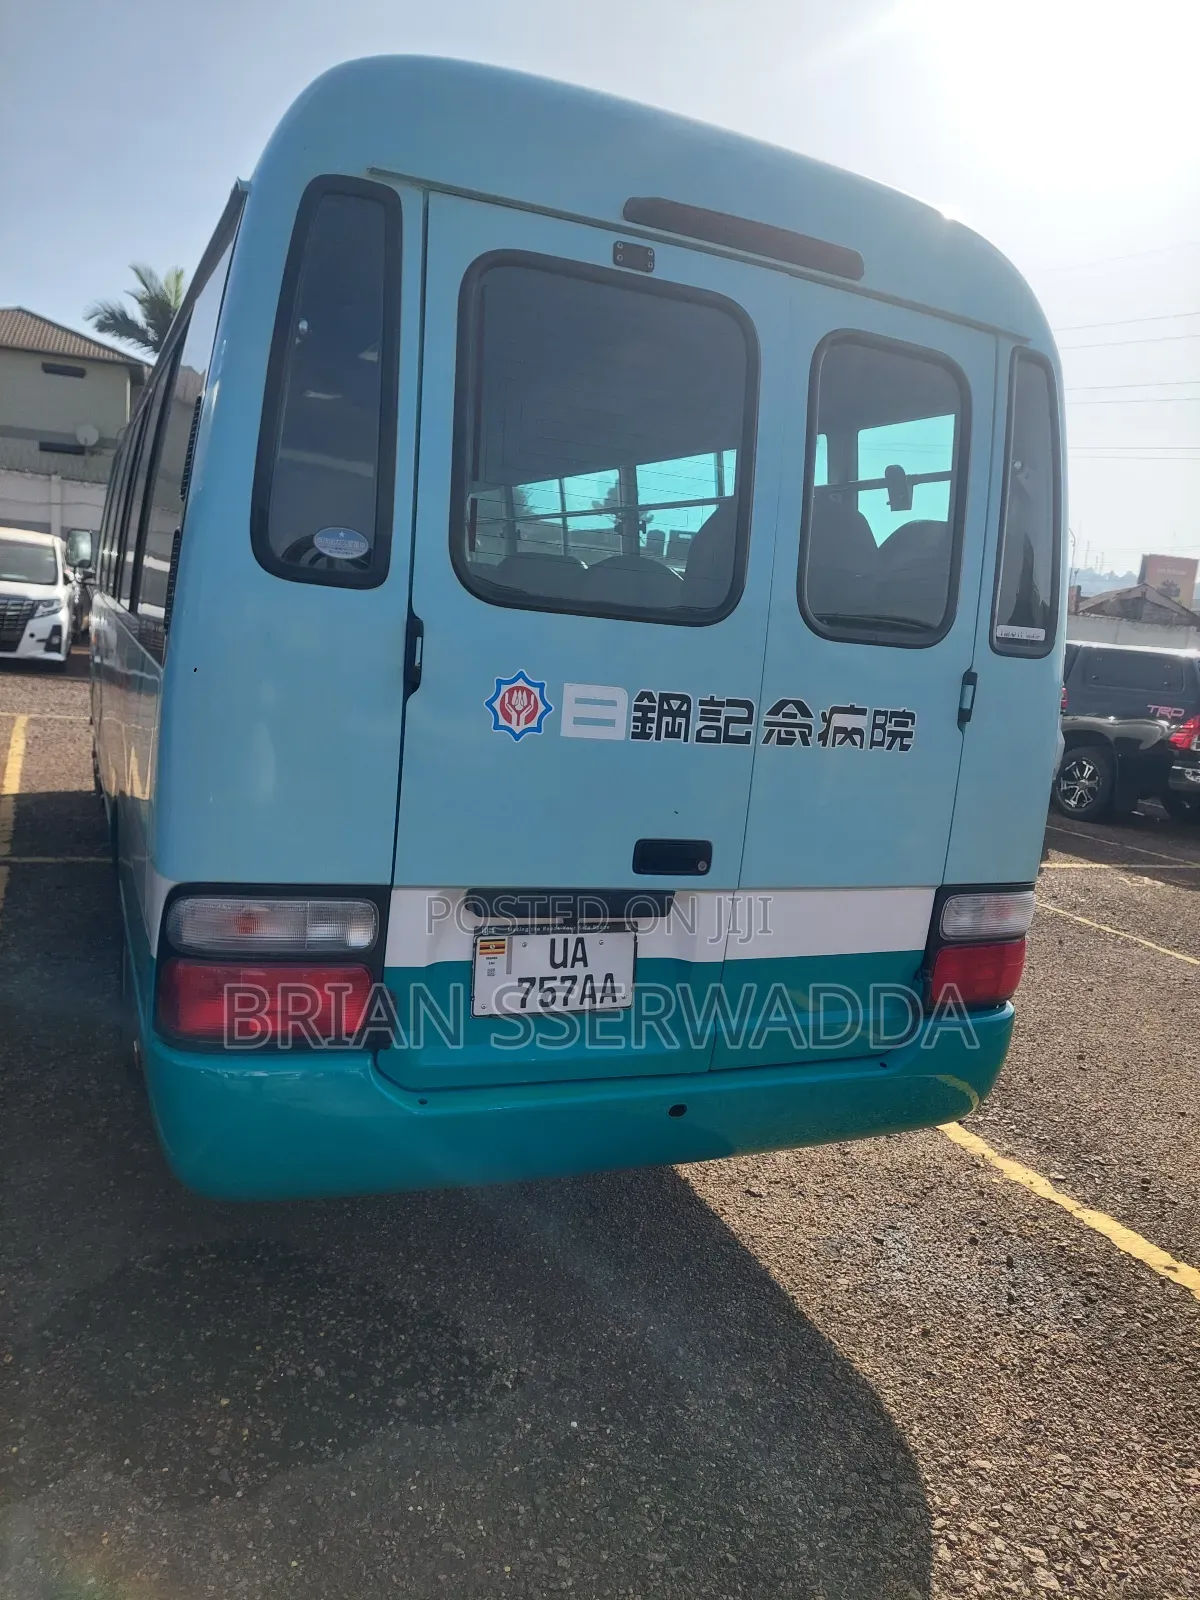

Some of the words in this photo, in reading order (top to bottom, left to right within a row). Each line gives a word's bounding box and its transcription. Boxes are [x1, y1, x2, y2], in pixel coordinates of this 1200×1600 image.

[560, 683, 916, 752] 日鋼記念病院
[1146, 704, 1185, 719] TRD
[549, 936, 589, 970] UA
[517, 972, 618, 1009] 757AA
